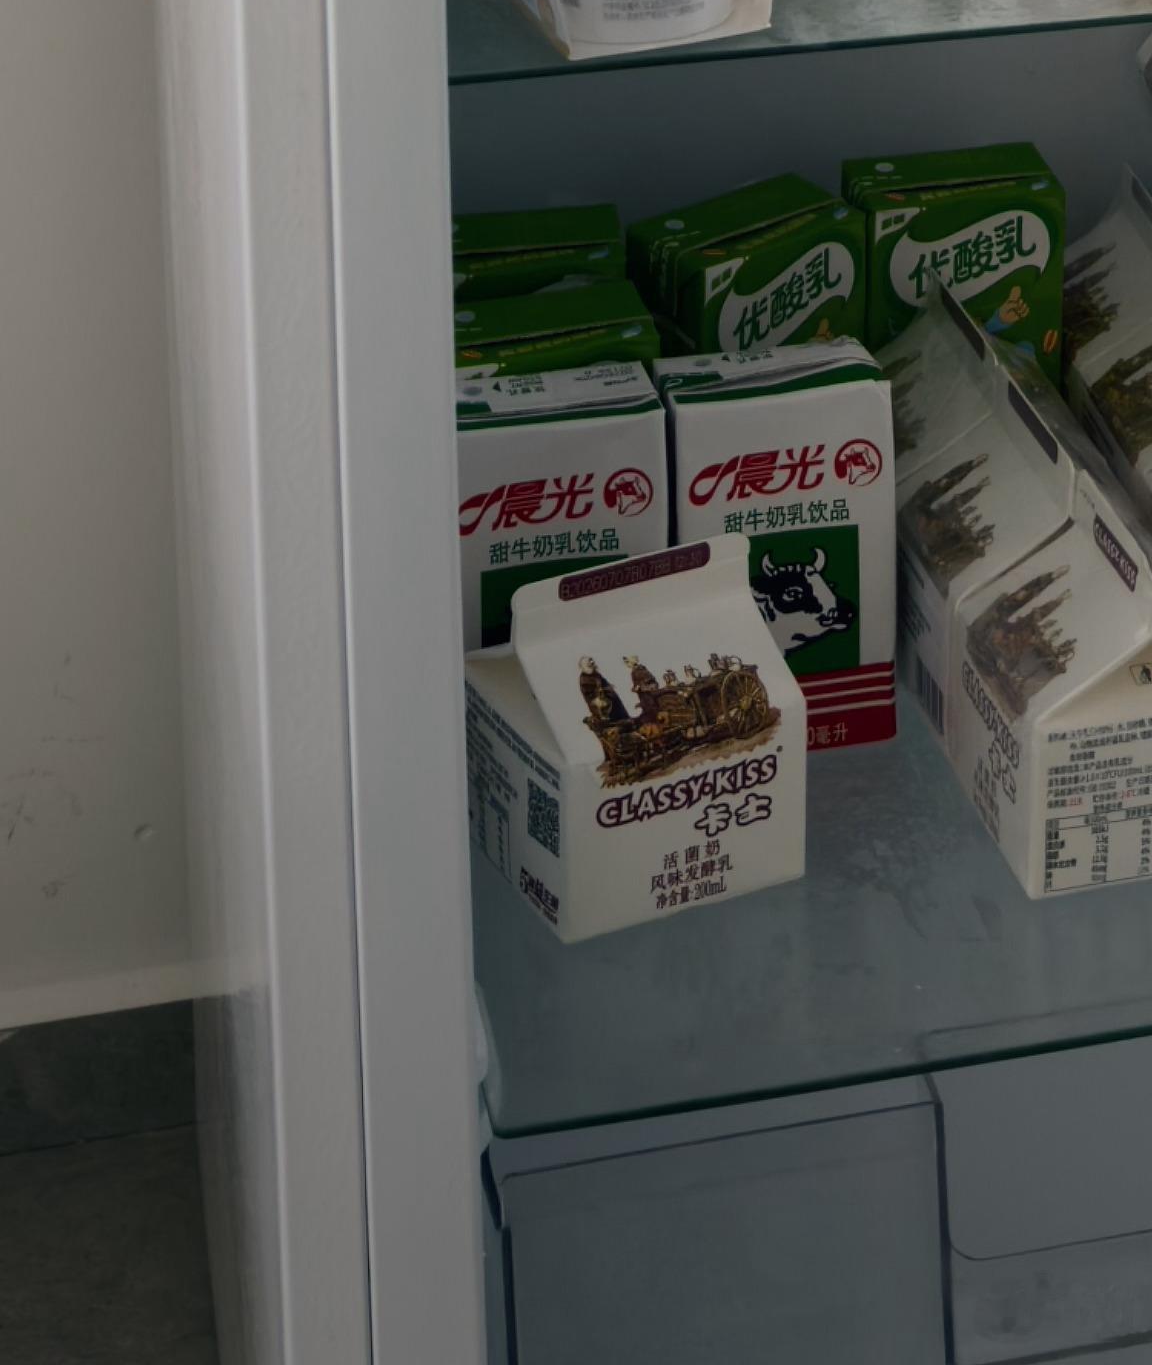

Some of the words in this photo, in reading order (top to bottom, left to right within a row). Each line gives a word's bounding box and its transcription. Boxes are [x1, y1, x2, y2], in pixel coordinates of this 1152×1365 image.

[733, 247, 842, 351] 优酸乳
[688, 443, 825, 507] 晨光
[459, 472, 594, 537] 晨光
[724, 498, 851, 534] 甜牛奶乳饮品
[489, 526, 620, 565] 甜牛奶乳饮品
[693, 792, 773, 838] 卡士
[651, 853, 733, 894] 风味发酵乳
[663, 838, 721, 870] 活菌奶
